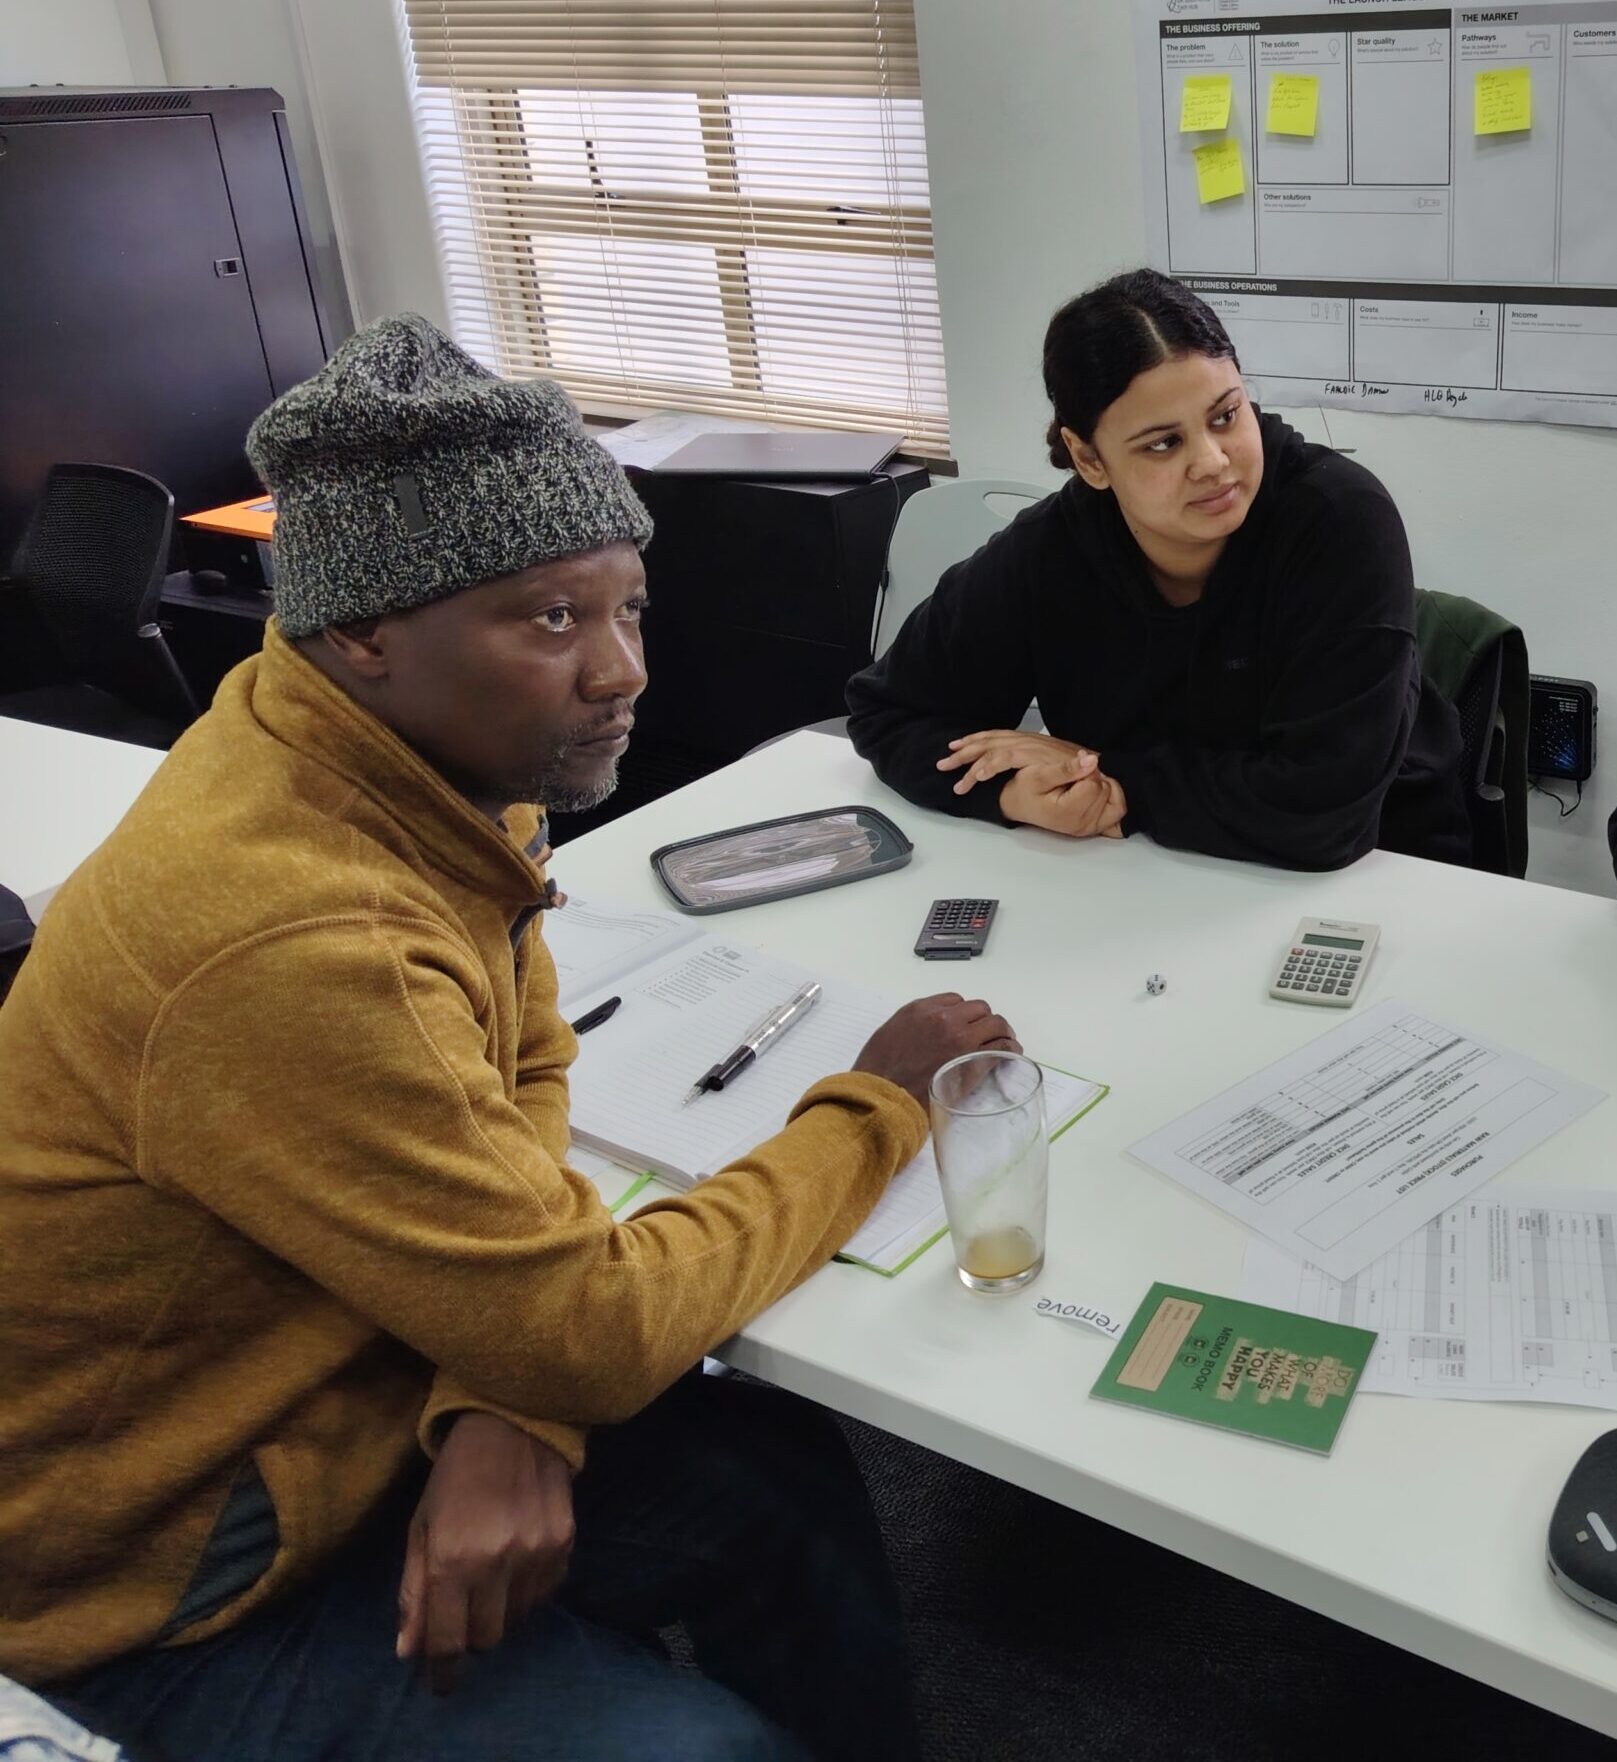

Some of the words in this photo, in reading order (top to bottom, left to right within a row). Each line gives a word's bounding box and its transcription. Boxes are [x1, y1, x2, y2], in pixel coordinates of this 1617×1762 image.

[1461, 14, 1478, 22] THE
[1481, 12, 1519, 22] MARKET
[1165, 25, 1181, 34] THE
[1183, 23, 1221, 33] BUSINESS
[1222, 22, 1261, 32] OFFERING
[1573, 30, 1617, 38] Customers
[1274, 40, 1300, 48] solution
[1357, 38, 1371, 46] Star
[1372, 37, 1396, 46] quality
[1461, 34, 1497, 42] Pathways
[1166, 44, 1179, 52] The
[1179, 43, 1206, 52] problem
[1263, 193, 1281, 201] Other
[1282, 193, 1312, 201] solutions
[1193, 281, 1230, 290] BUSINESS
[1231, 282, 1278, 292] OPERATIONS
[1511, 311, 1538, 319] Income
[1405, 1132, 1426, 1145] SALES
[1443, 1139, 1477, 1162] MATERIALS
[1449, 1154, 1484, 1177] PURCHASES
[1407, 1173, 1427, 1186] PRICE
[1394, 1184, 1411, 1195] LIST
[1036, 1297, 1121, 1335] remove
[1209, 1326, 1233, 1359] MEMO
[1221, 1346, 1253, 1391] HAPPY
[1246, 1350, 1270, 1378] YOU
[1303, 1362, 1317, 1379] OF
[1191, 1361, 1215, 1391] BOOK
[1258, 1353, 1285, 1391] MAKES
[1277, 1358, 1299, 1392] WHAT
[1333, 1369, 1349, 1388] DO
